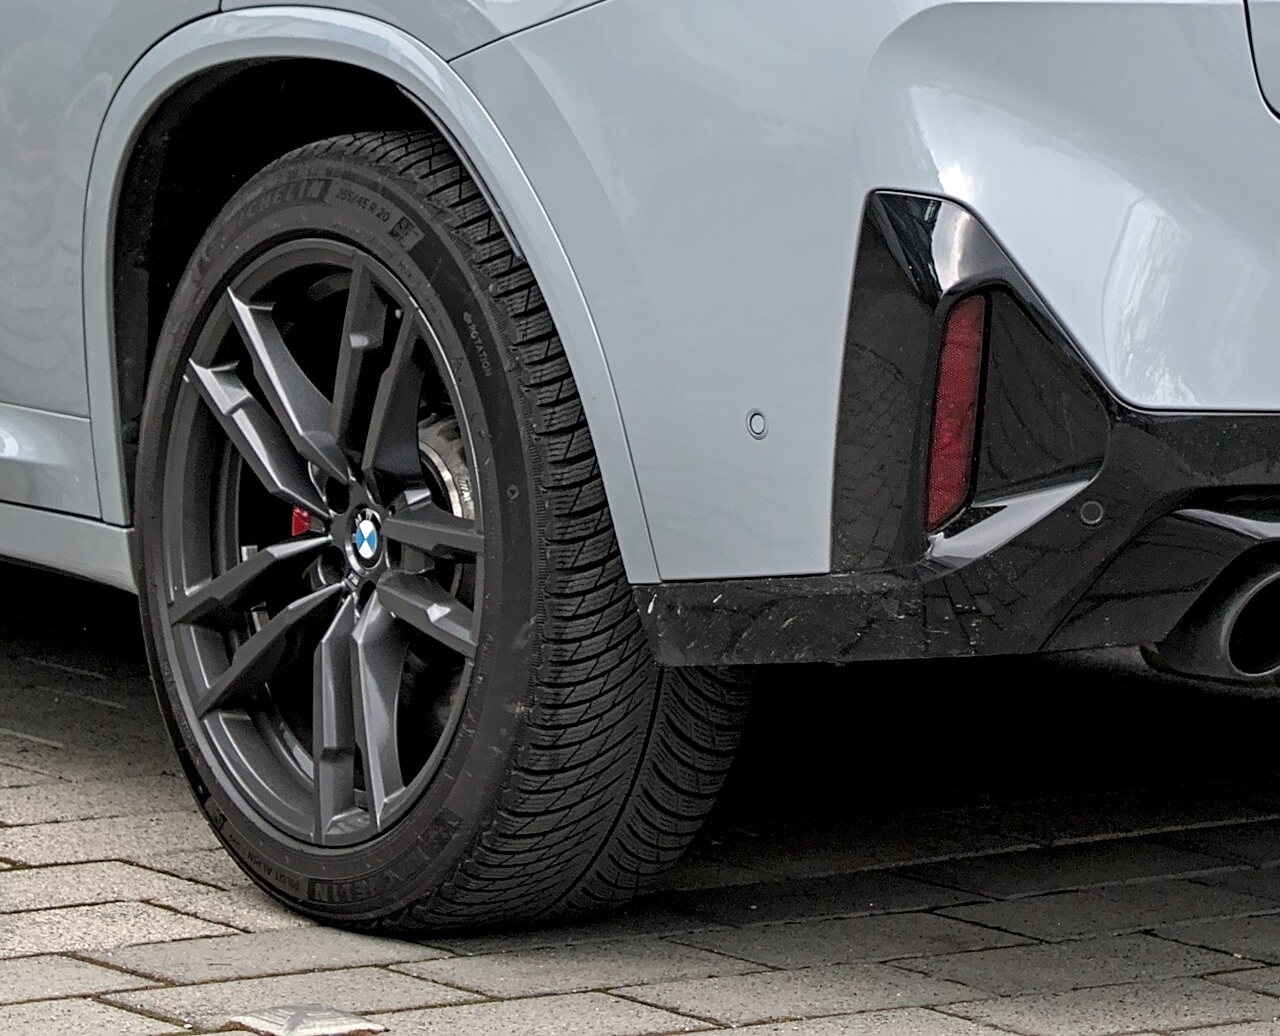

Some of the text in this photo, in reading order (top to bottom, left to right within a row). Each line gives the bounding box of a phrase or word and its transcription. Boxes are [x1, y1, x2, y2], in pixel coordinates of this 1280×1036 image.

[375, 207, 391, 223] 20
[468, 323, 493, 378] ROTATION
[247, 851, 273, 876] ALPIN
